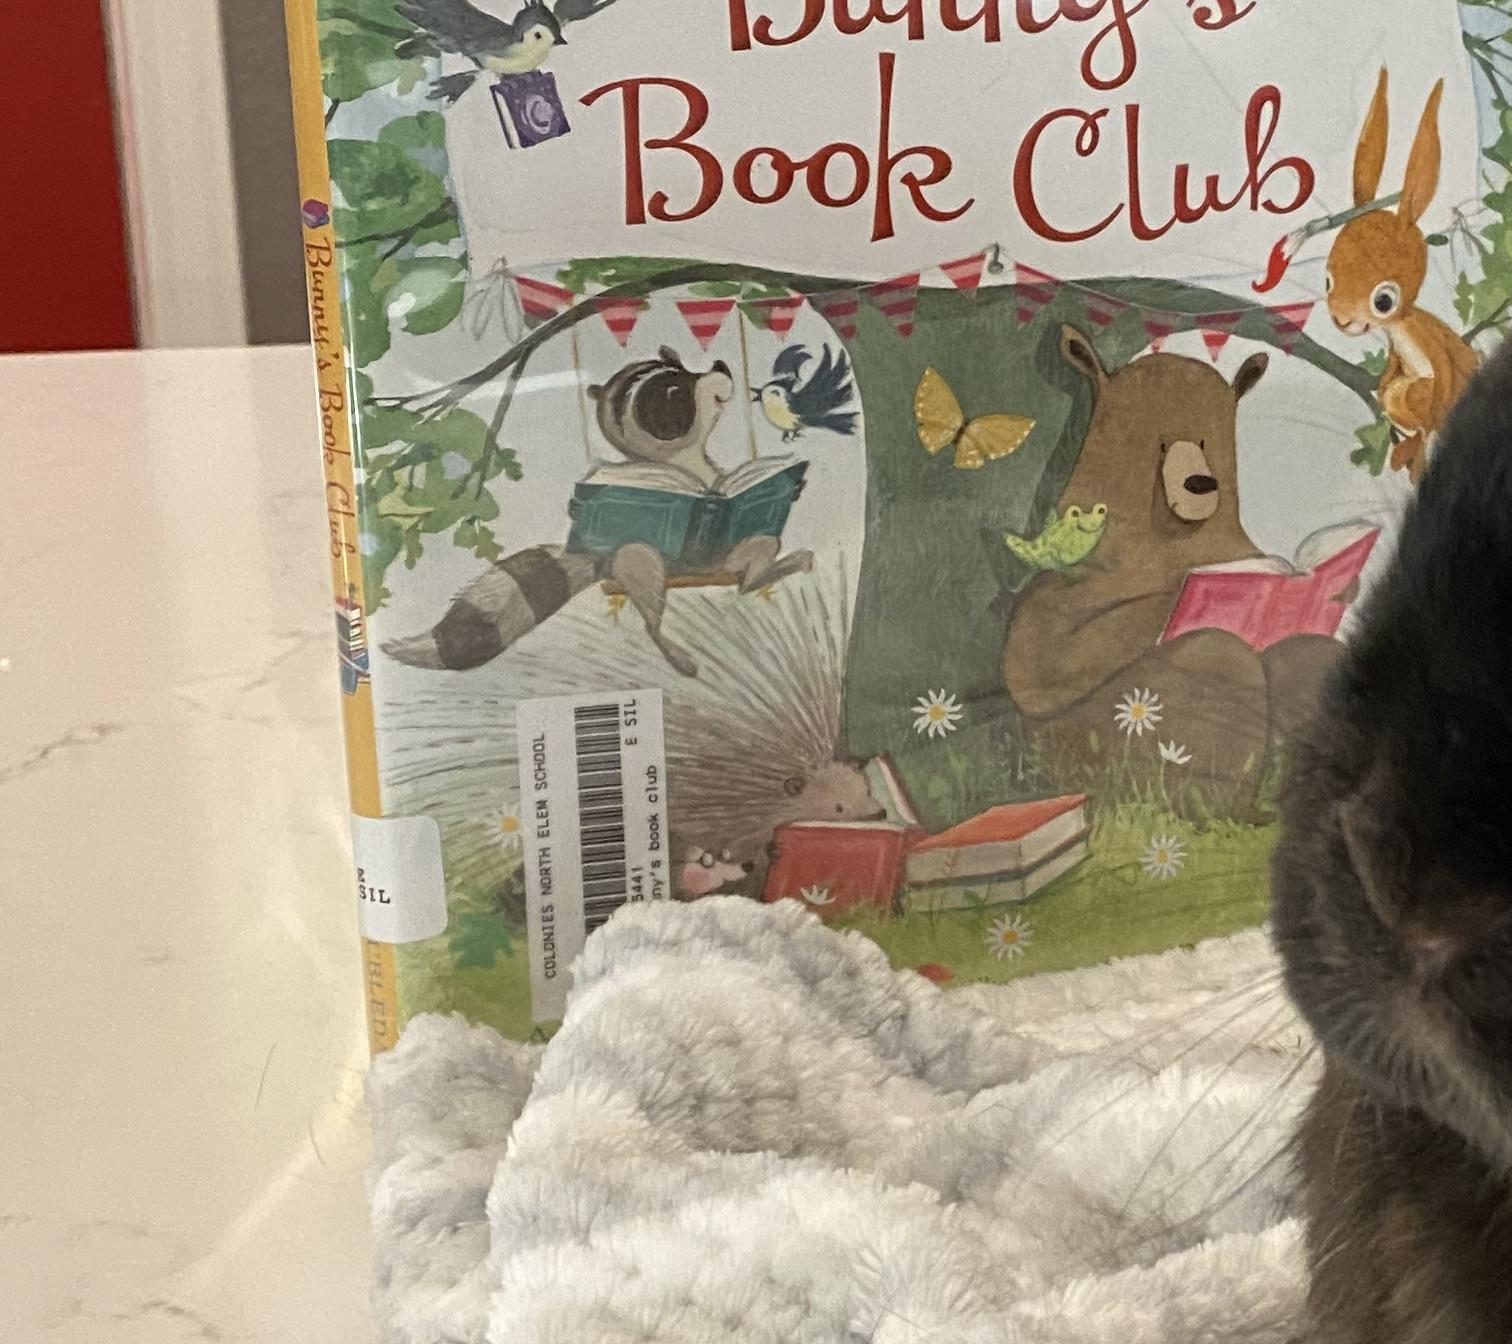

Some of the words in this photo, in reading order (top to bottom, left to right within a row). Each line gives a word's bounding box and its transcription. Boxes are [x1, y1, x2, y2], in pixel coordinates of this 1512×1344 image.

[578, 51, 975, 243] Book
[1012, 84, 1316, 243] Club
[305, 236, 340, 371] Bunny's
[318, 382, 352, 466] Book
[325, 481, 356, 559] Club
[623, 698, 638, 727] SIL
[532, 732, 548, 791] SCHOOL
[624, 736, 638, 746] E
[645, 764, 658, 803] club
[535, 798, 551, 839] ELEM
[647, 812, 660, 851] book
[538, 846, 553, 896] NORTH
[631, 866, 644, 902] 5441
[650, 859, 665, 898] ny's
[358, 883, 391, 904] SIL
[541, 903, 557, 980] COLONIES
